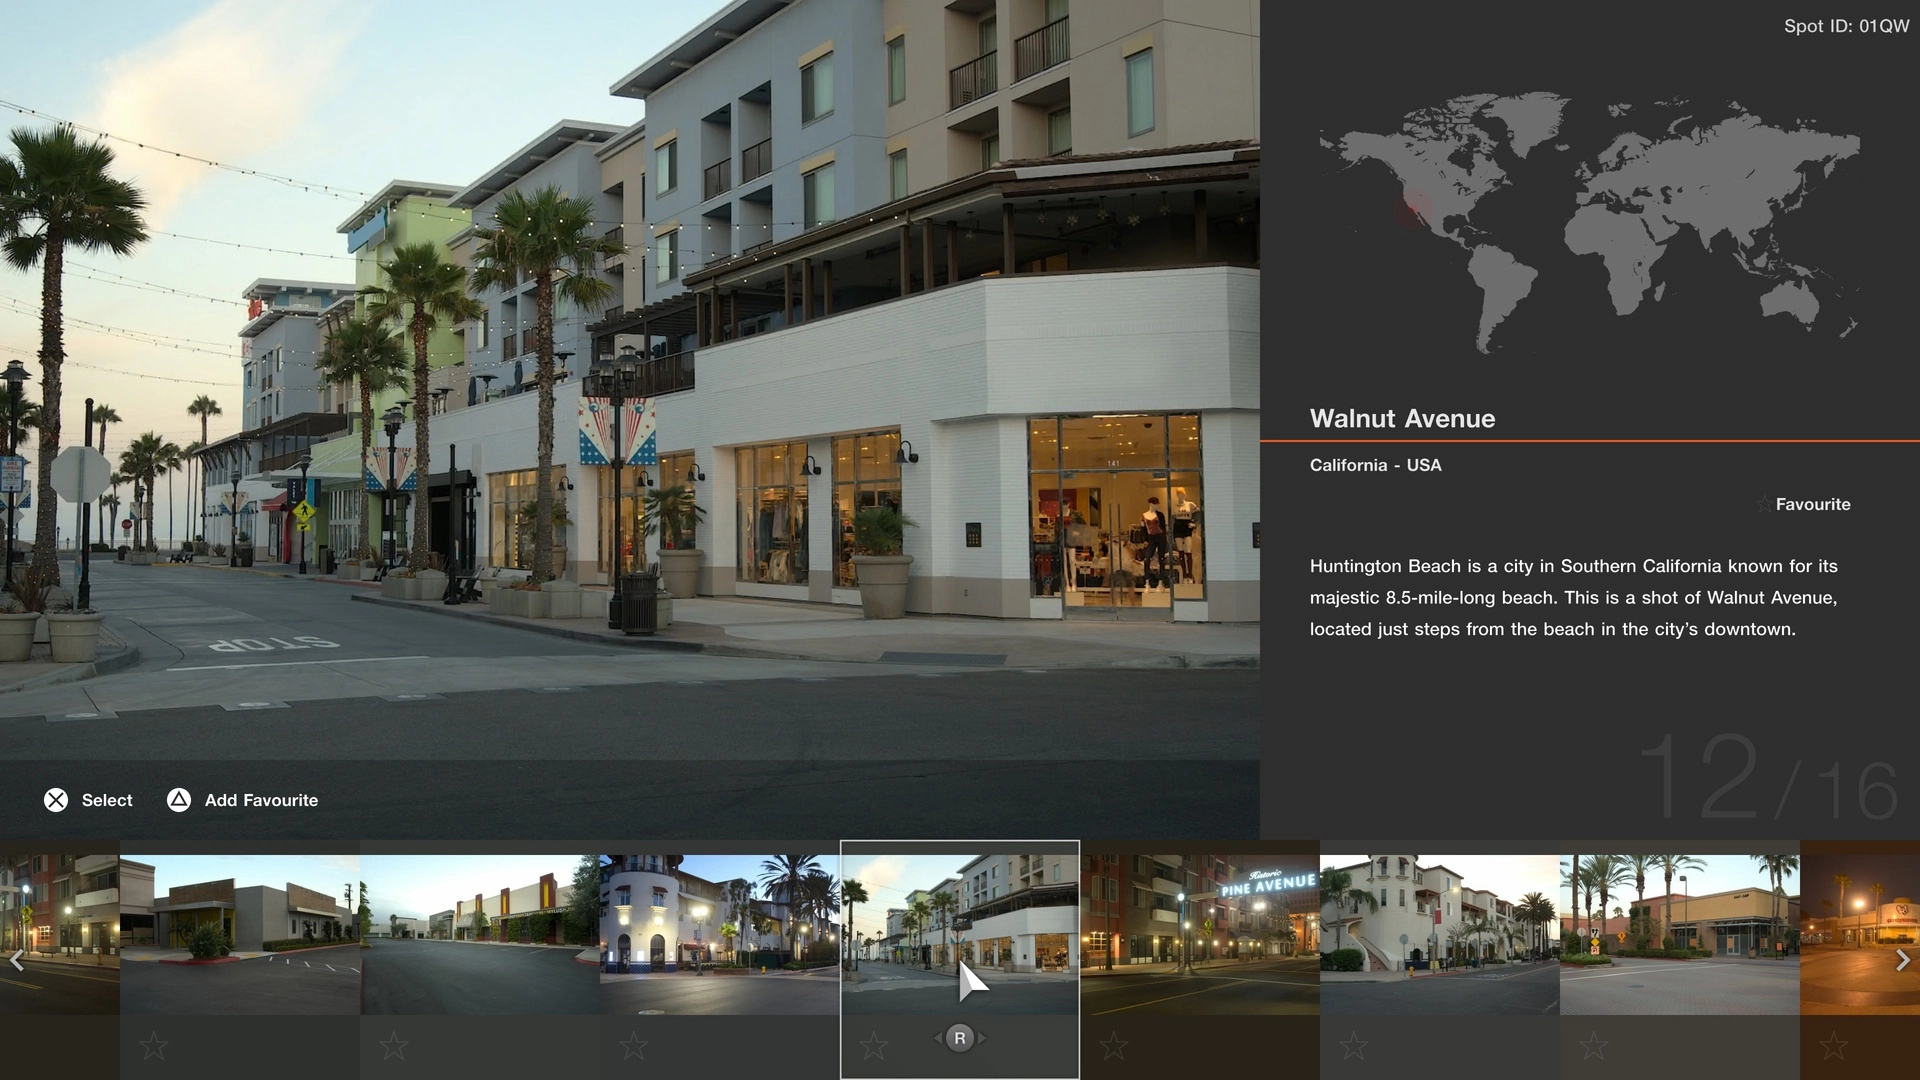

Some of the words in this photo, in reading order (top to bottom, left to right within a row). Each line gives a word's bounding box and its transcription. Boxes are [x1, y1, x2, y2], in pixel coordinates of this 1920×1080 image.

[207, 636, 342, 653] STOP
[1248, 868, 1283, 881] Historic
[1221, 883, 1251, 897] PINE
[1255, 873, 1316, 893] AVENUE
